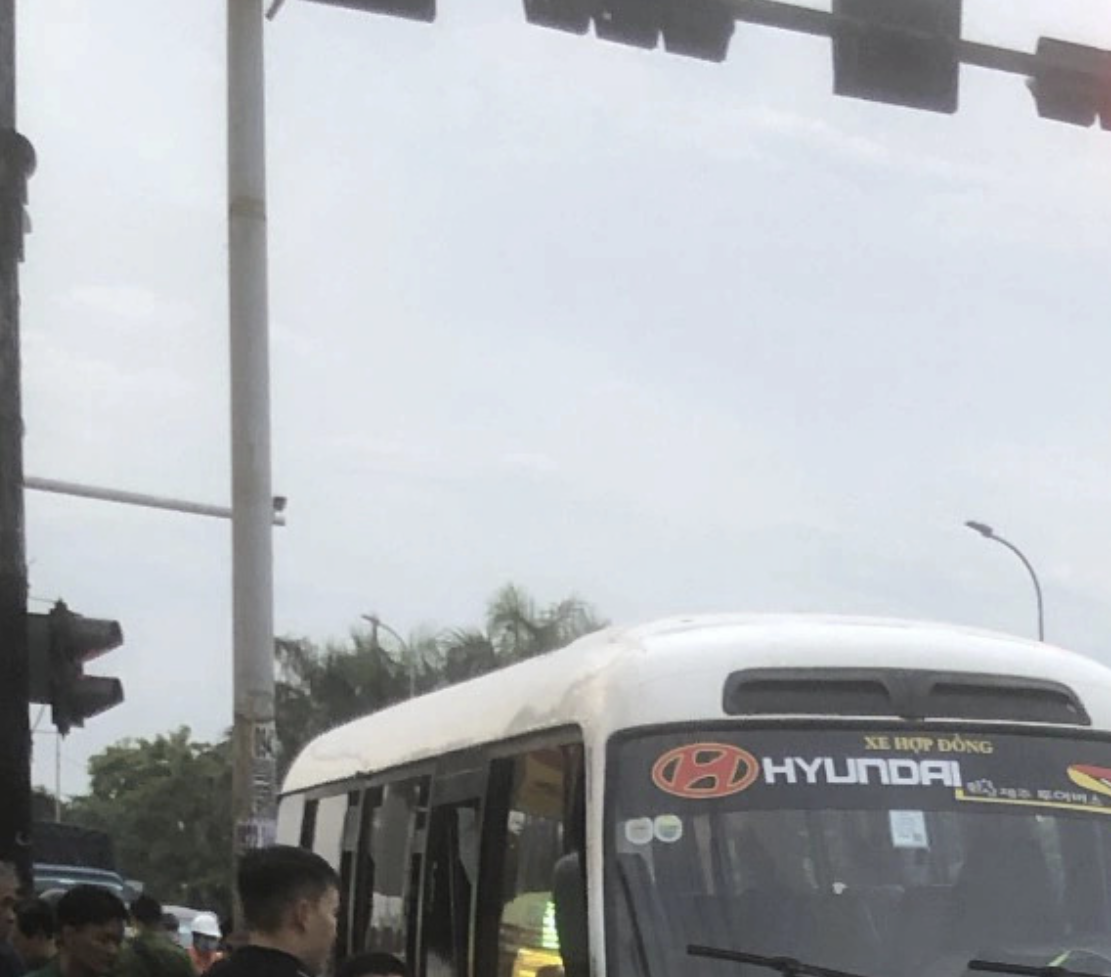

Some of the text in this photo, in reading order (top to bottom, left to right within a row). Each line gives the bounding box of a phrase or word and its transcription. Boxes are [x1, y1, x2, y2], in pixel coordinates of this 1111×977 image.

[863, 736, 891, 750] XE
[894, 736, 934, 754] HỢP
[762, 757, 962, 787] HYUNDAI
